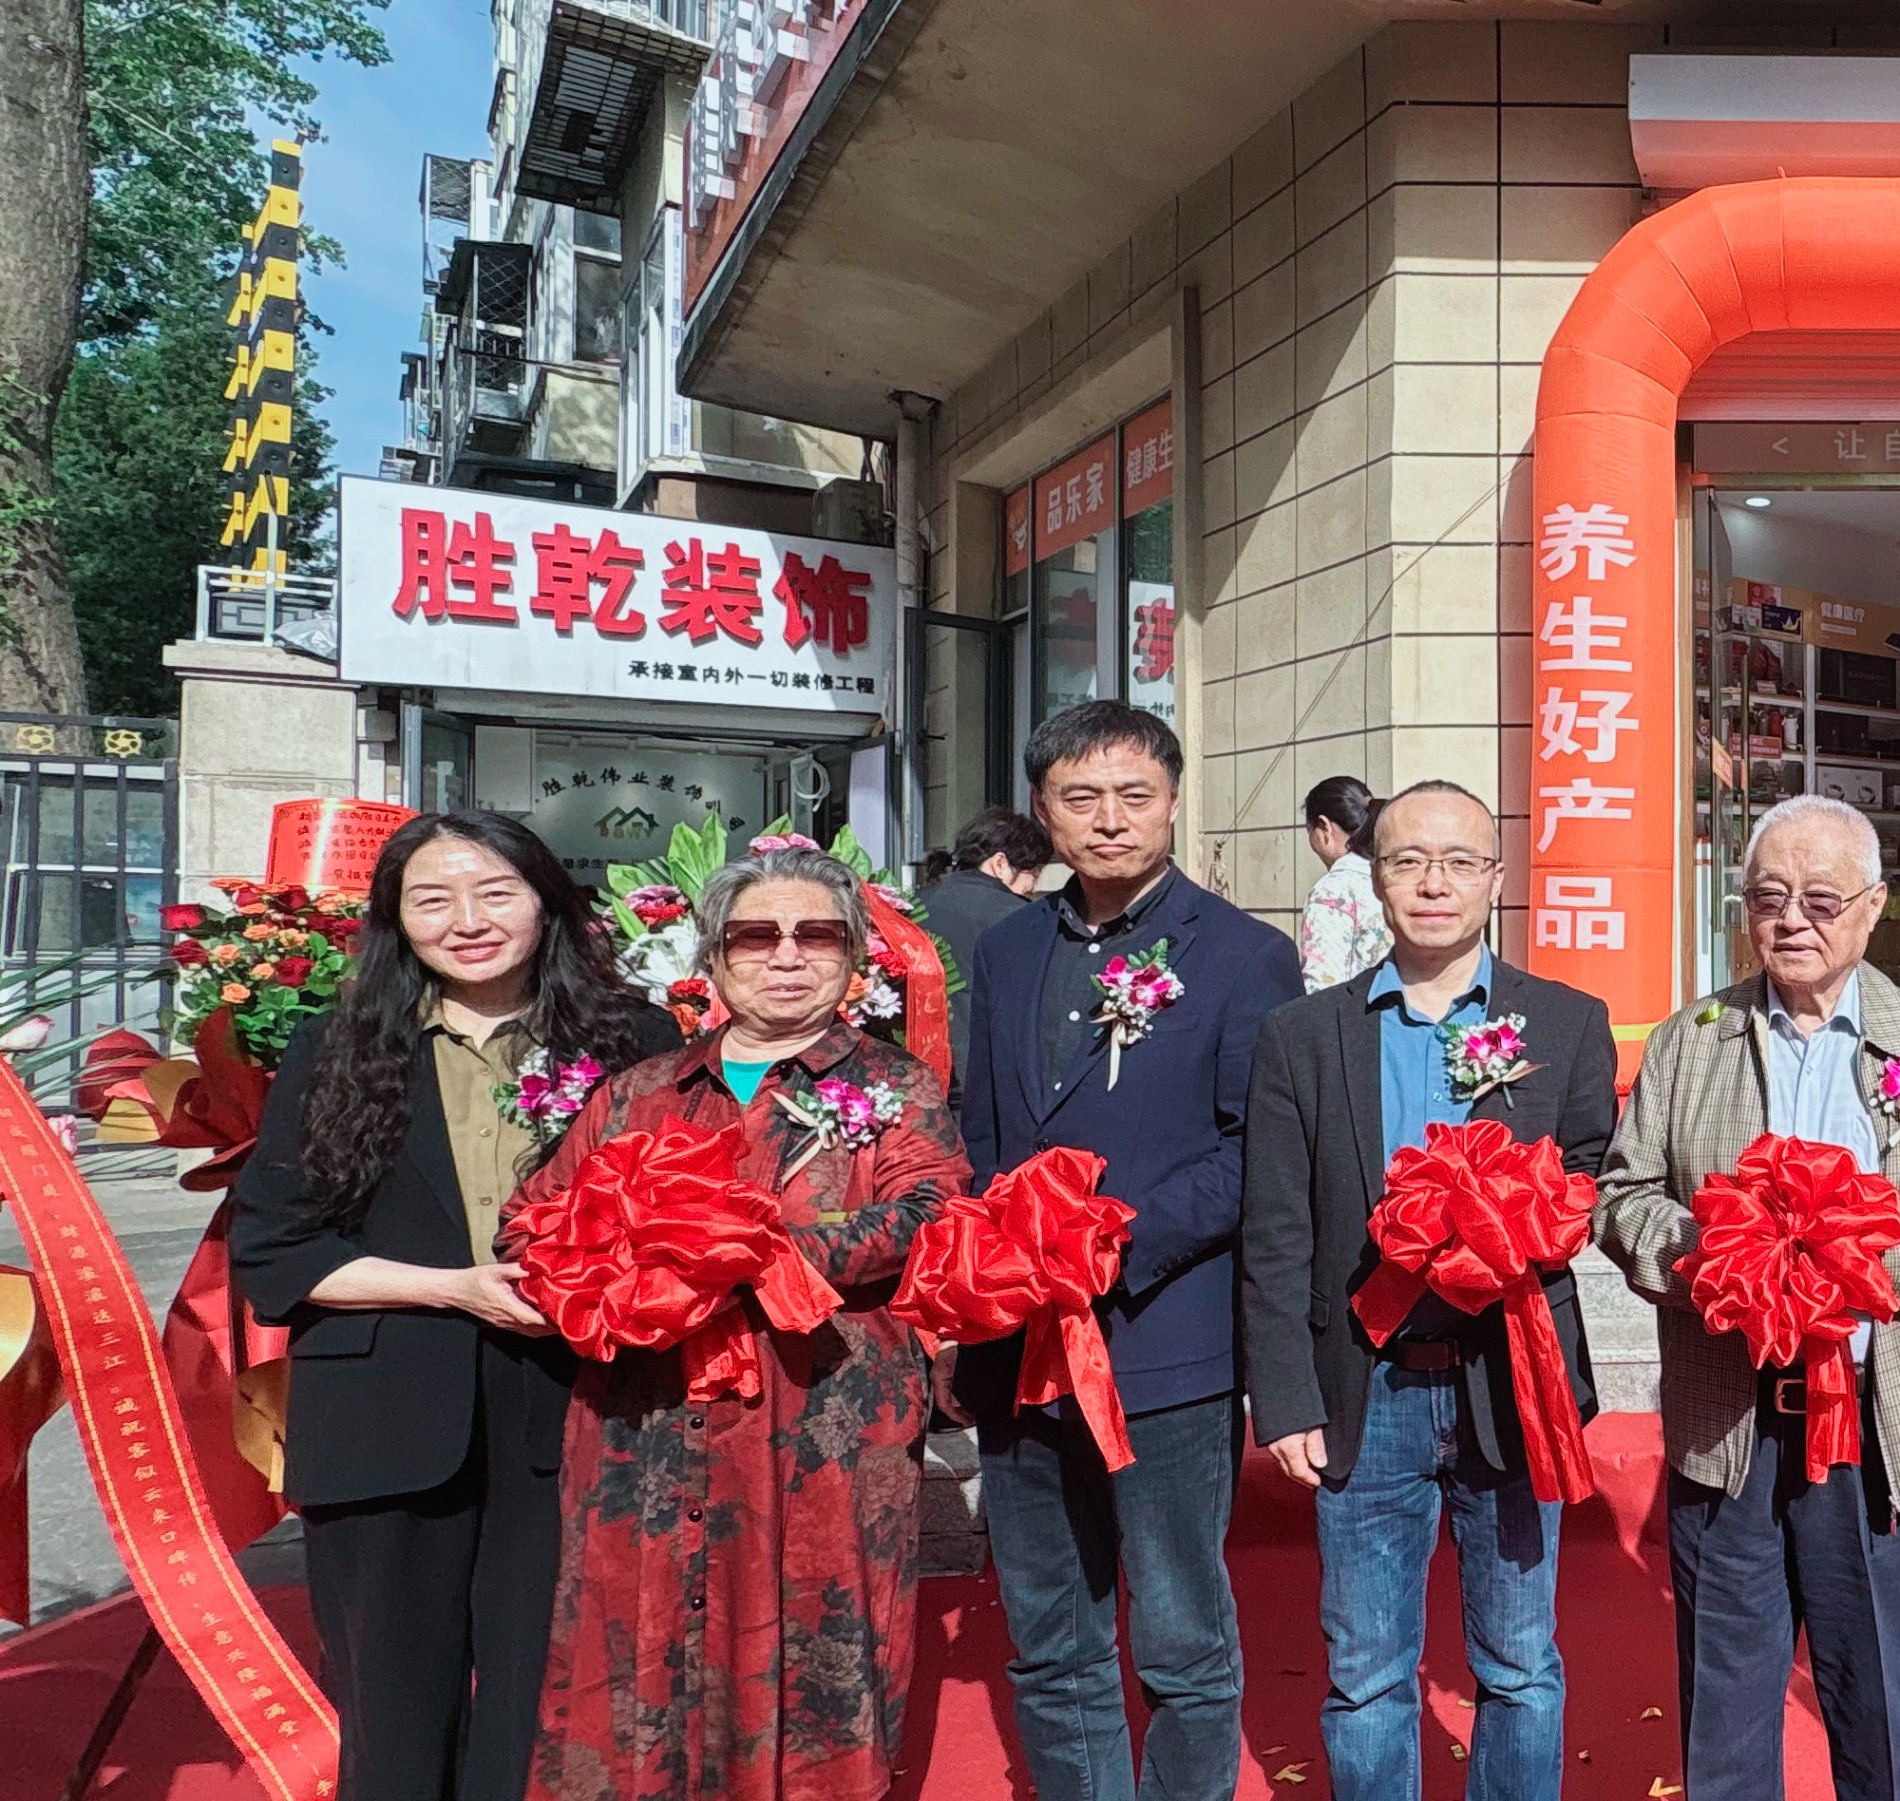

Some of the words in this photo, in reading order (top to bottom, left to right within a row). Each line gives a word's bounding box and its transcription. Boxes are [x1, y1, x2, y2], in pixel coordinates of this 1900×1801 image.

[1047, 462, 1104, 535] 品乐家
[393, 507, 873, 654] 胜乾装饰
[628, 660, 876, 695] 承接室内外一切装修工程
[1536, 503, 1640, 951] 养生好产品
